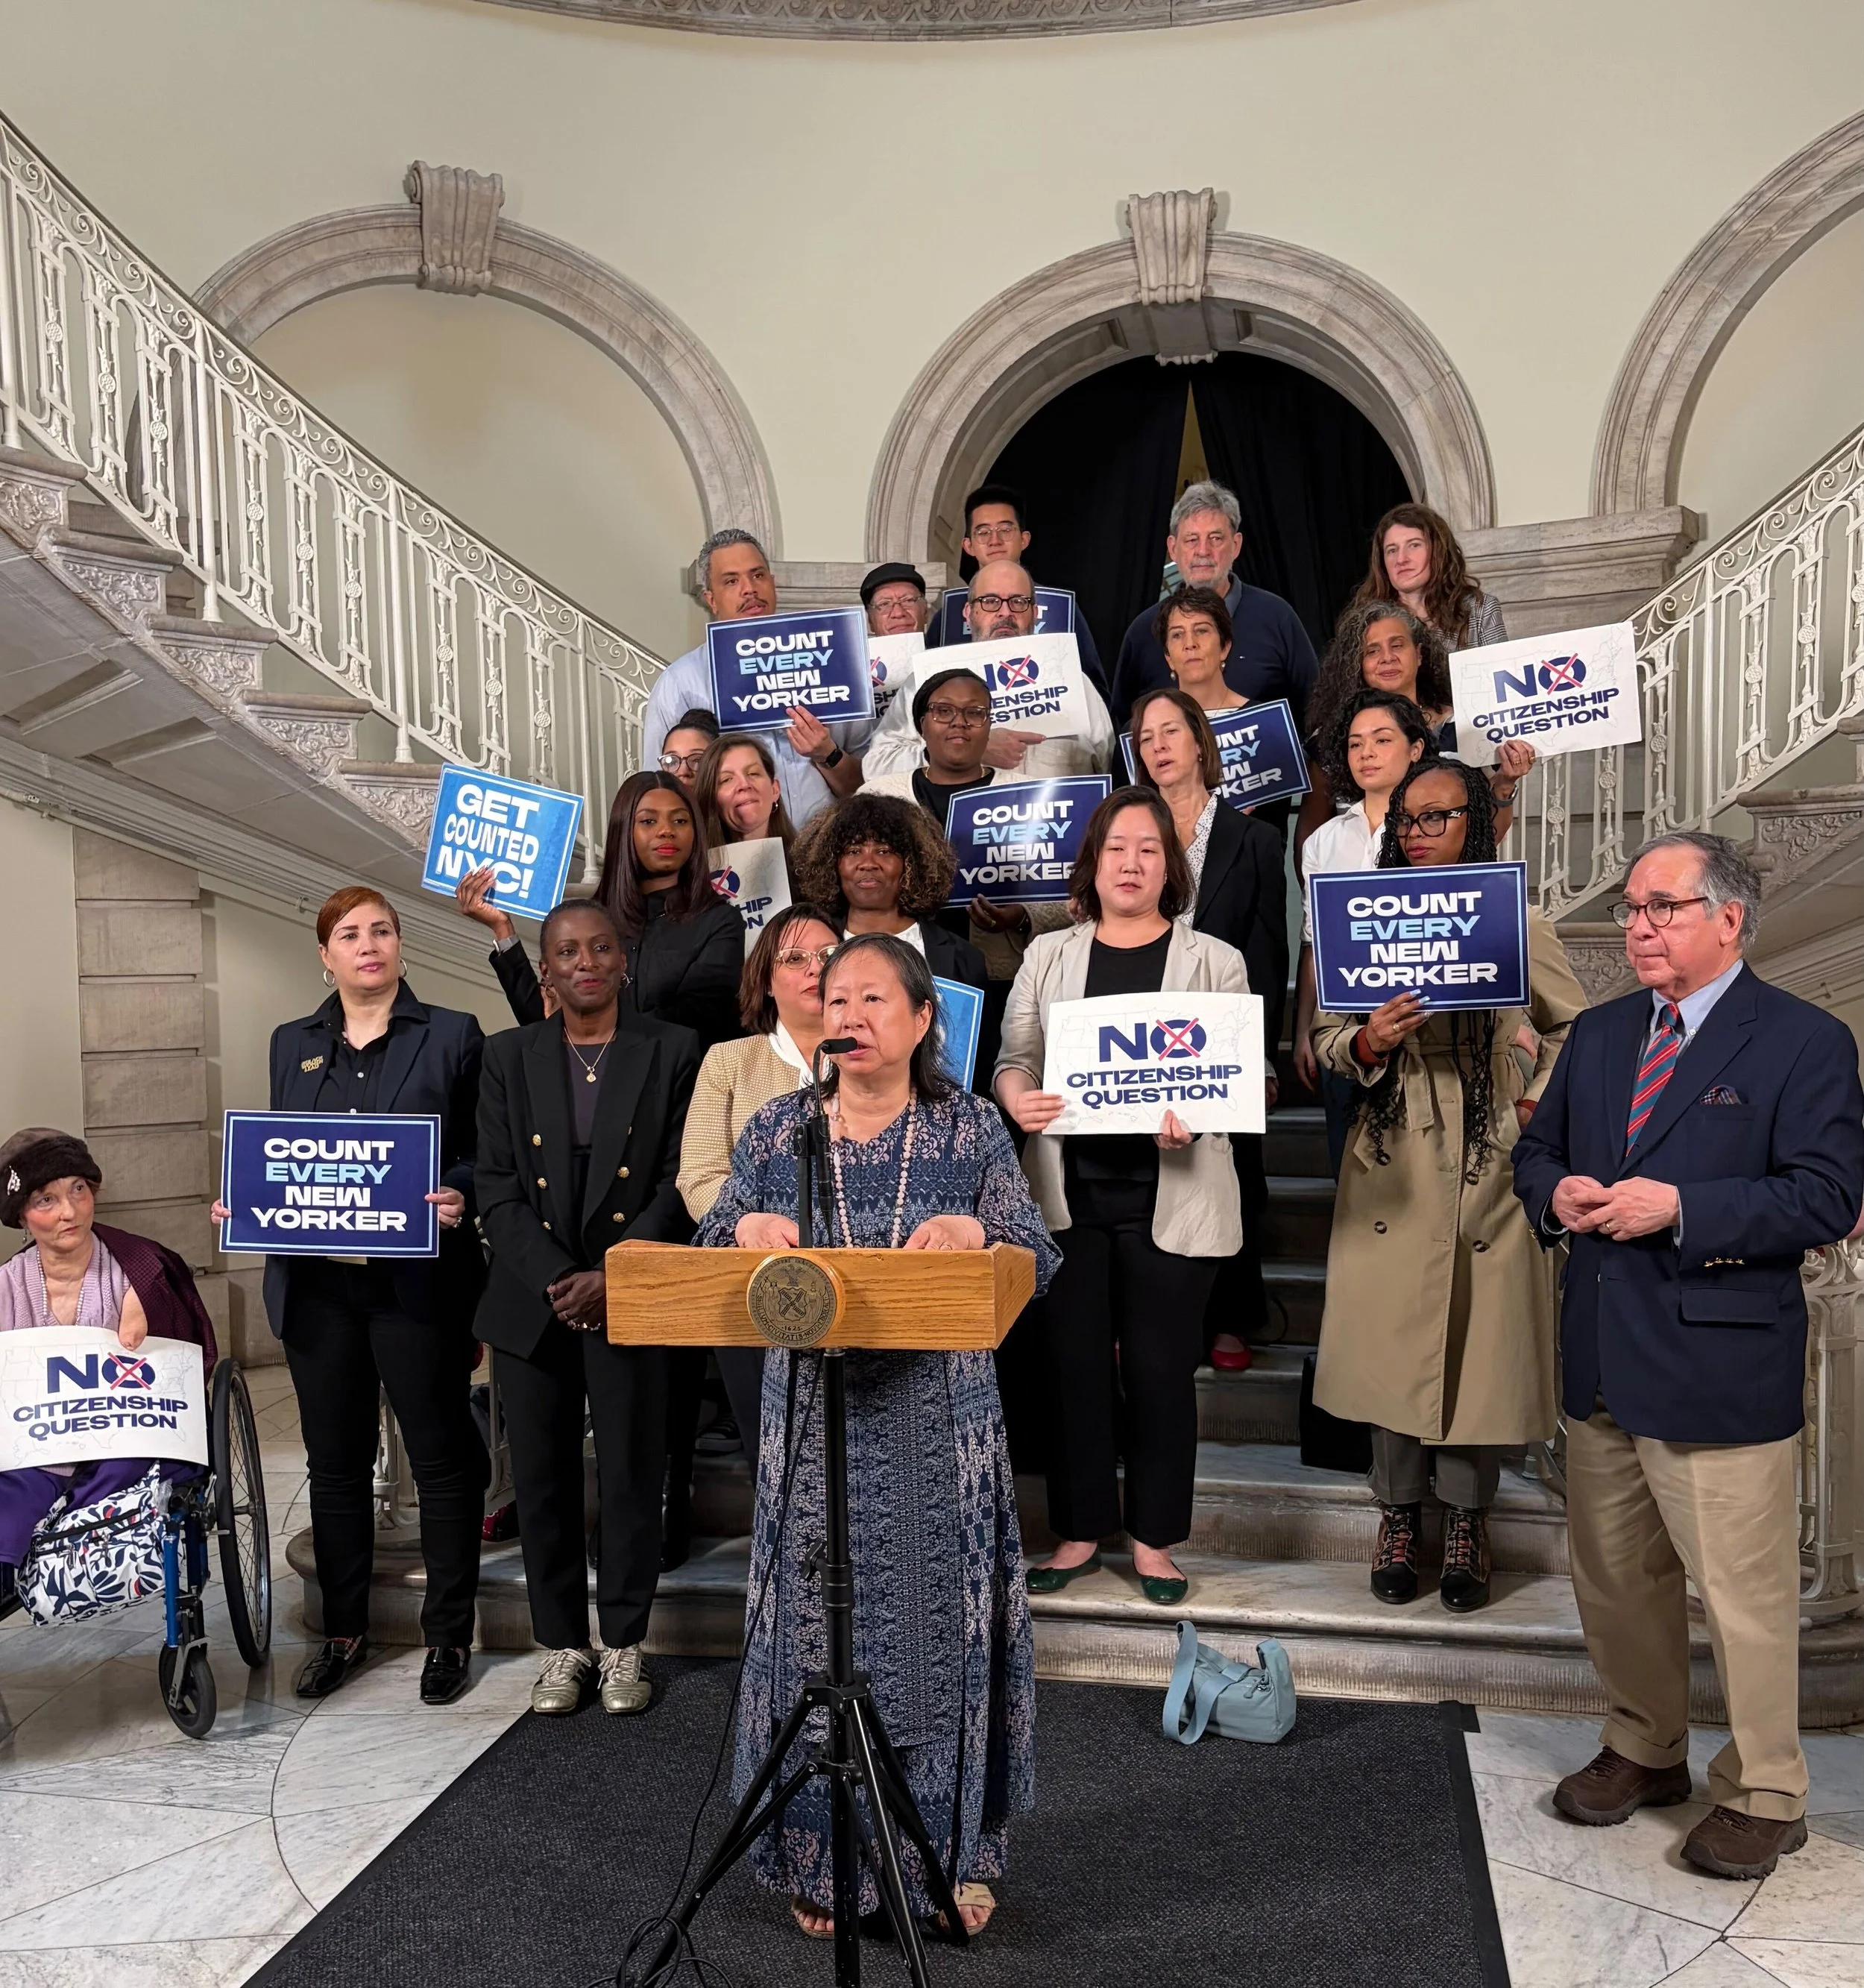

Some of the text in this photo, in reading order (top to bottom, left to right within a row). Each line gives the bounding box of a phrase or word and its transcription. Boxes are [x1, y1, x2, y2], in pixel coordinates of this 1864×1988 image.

[736, 630, 833, 656] COUNT
[739, 649, 834, 675] EVERY
[756, 669, 821, 692] NEW
[1493, 655, 1587, 704] NO
[732, 685, 850, 712] YORKER
[992, 685, 1068, 709] ENSHIP
[1473, 688, 1619, 729] CITIZENSHIP
[1486, 705, 1609, 744] QUESTION
[1221, 767, 1282, 799] KER
[456, 784, 540, 829] GET
[972, 800, 1074, 825] COUNT
[444, 814, 539, 865] COUNTED
[972, 821, 1072, 845] EVERY
[986, 842, 1054, 864] NEW
[435, 845, 534, 899] NYC!
[1347, 891, 1482, 918] COUNT
[1350, 915, 1481, 941] EVERY
[1370, 940, 1459, 963] NEW
[1338, 963, 1498, 987] YORKER
[1098, 1019, 1206, 1063] NO
[1066, 1065, 1242, 1088] CITIZENSHIP
[1082, 1083, 1228, 1110] QUESTION
[264, 1137, 394, 1161] COUNT
[265, 1162, 393, 1184] EVERY
[285, 1185, 371, 1207] NEW
[251, 1207, 407, 1231] YORKER
[47, 1353, 156, 1394] NO
[13, 1395, 189, 1422] CITIZENSHIP
[28, 1413, 177, 1441] QUESTION
